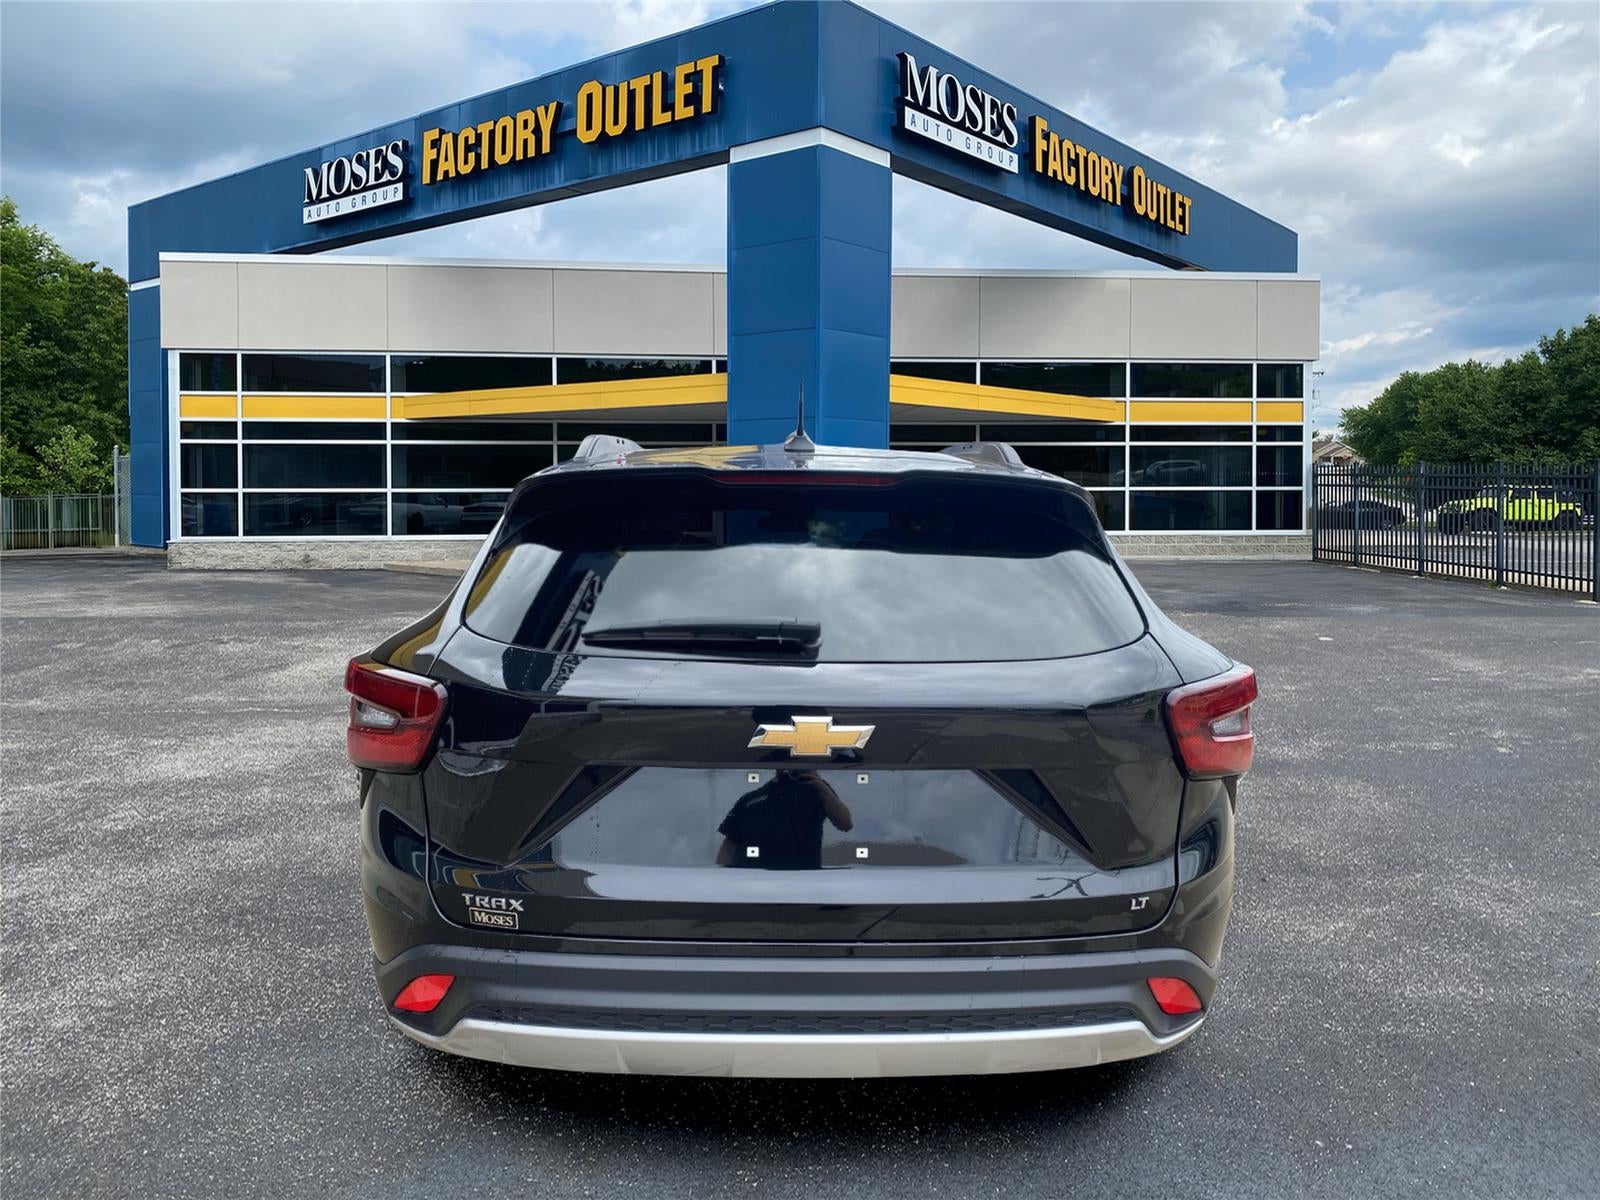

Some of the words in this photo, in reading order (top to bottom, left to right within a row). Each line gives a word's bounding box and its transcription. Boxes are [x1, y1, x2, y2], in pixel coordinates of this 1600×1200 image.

[422, 101, 559, 185] FACTORY
[576, 54, 720, 144] OUTLET
[904, 52, 1019, 149] MOSES
[910, 113, 953, 142] AUTO
[965, 136, 1014, 167] GROUP
[303, 140, 404, 204] MOSES
[1035, 115, 1124, 206] FACTORY
[1132, 164, 1193, 236] OUTLET
[306, 201, 341, 220] AUTO
[351, 186, 400, 209] GROUP
[461, 892, 524, 912] TRAX
[472, 910, 515, 927] MOSES
[1130, 896, 1150, 911] LT
